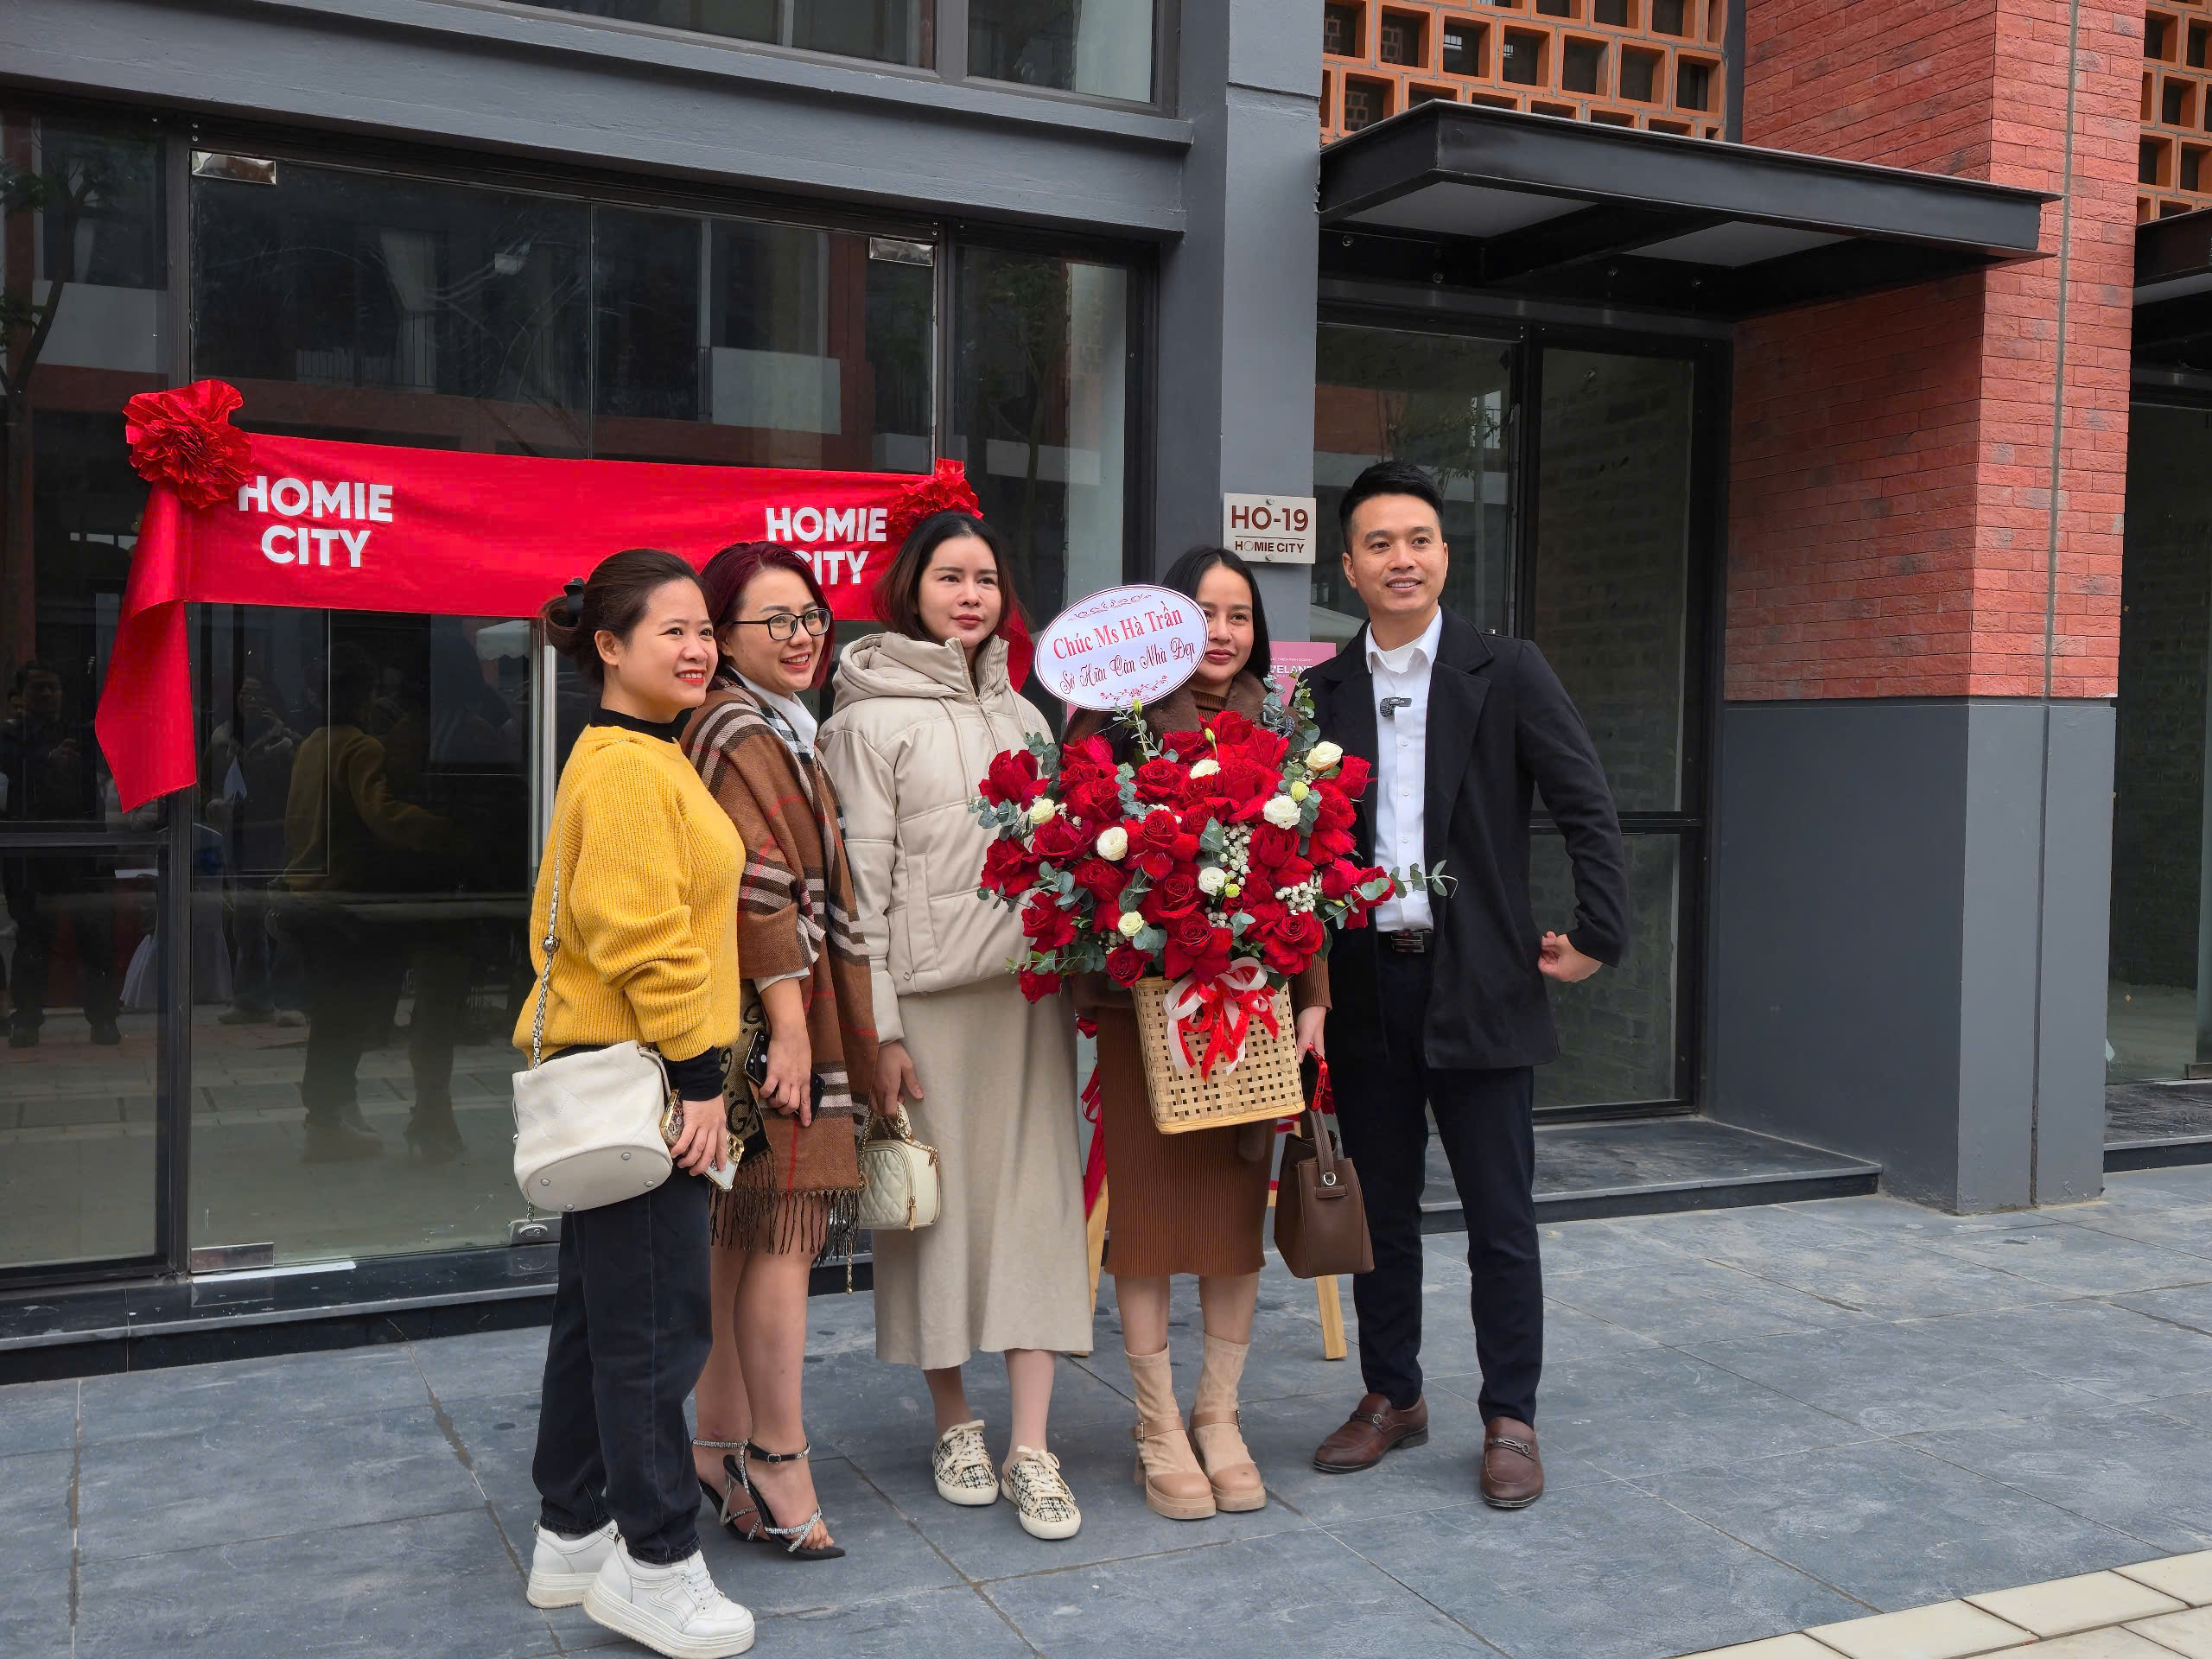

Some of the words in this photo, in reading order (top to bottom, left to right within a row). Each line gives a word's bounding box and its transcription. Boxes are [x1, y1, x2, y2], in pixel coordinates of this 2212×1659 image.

[238, 476, 392, 522] HOMIE
[766, 507, 887, 542] HOMIE
[1231, 505, 1308, 531] HO-19
[261, 525, 371, 567] CITY
[1235, 540, 1274, 552] HOMIE
[1276, 543, 1305, 553] CITY
[1053, 632, 1093, 659] Chúc
[1093, 625, 1120, 647] Ms
[1119, 615, 1145, 639] Hà
[1144, 601, 1184, 632] Trần
[1140, 644, 1167, 669] Nhà
